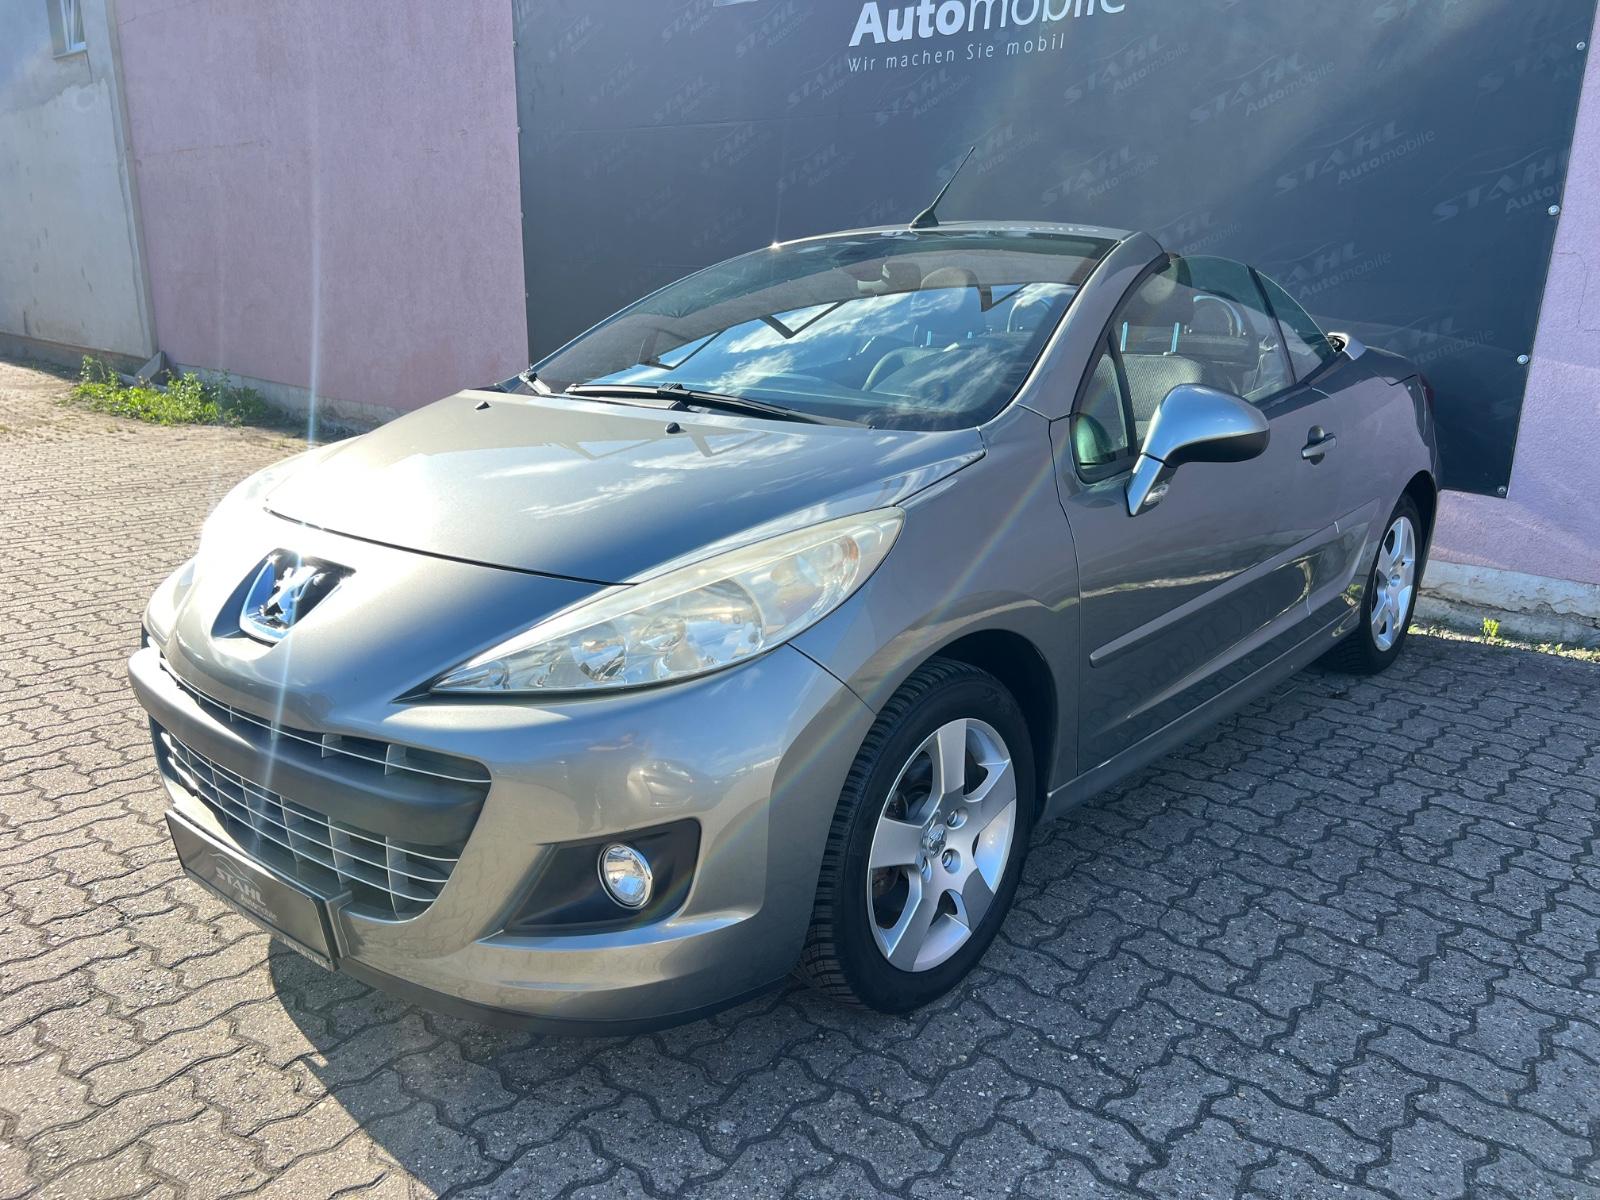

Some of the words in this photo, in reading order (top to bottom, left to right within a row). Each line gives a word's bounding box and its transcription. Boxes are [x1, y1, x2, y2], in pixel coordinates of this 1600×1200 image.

[848, 57, 876, 72] Wir
[886, 49, 955, 69] machen
[966, 43, 994, 60] Sie
[1006, 33, 1065, 56] mobil
[1064, 34, 1168, 107] STAHL
[1190, 53, 1307, 128] STAHL
[1245, 59, 1336, 117] Automobile
[1042, 145, 1136, 207] STAHL
[1274, 120, 1407, 197] STAHL
[1338, 129, 1436, 185] Automobile
[1284, 241, 1365, 288] AHL
[1299, 250, 1392, 300] Automobile
[216, 866, 266, 906] STAHL
